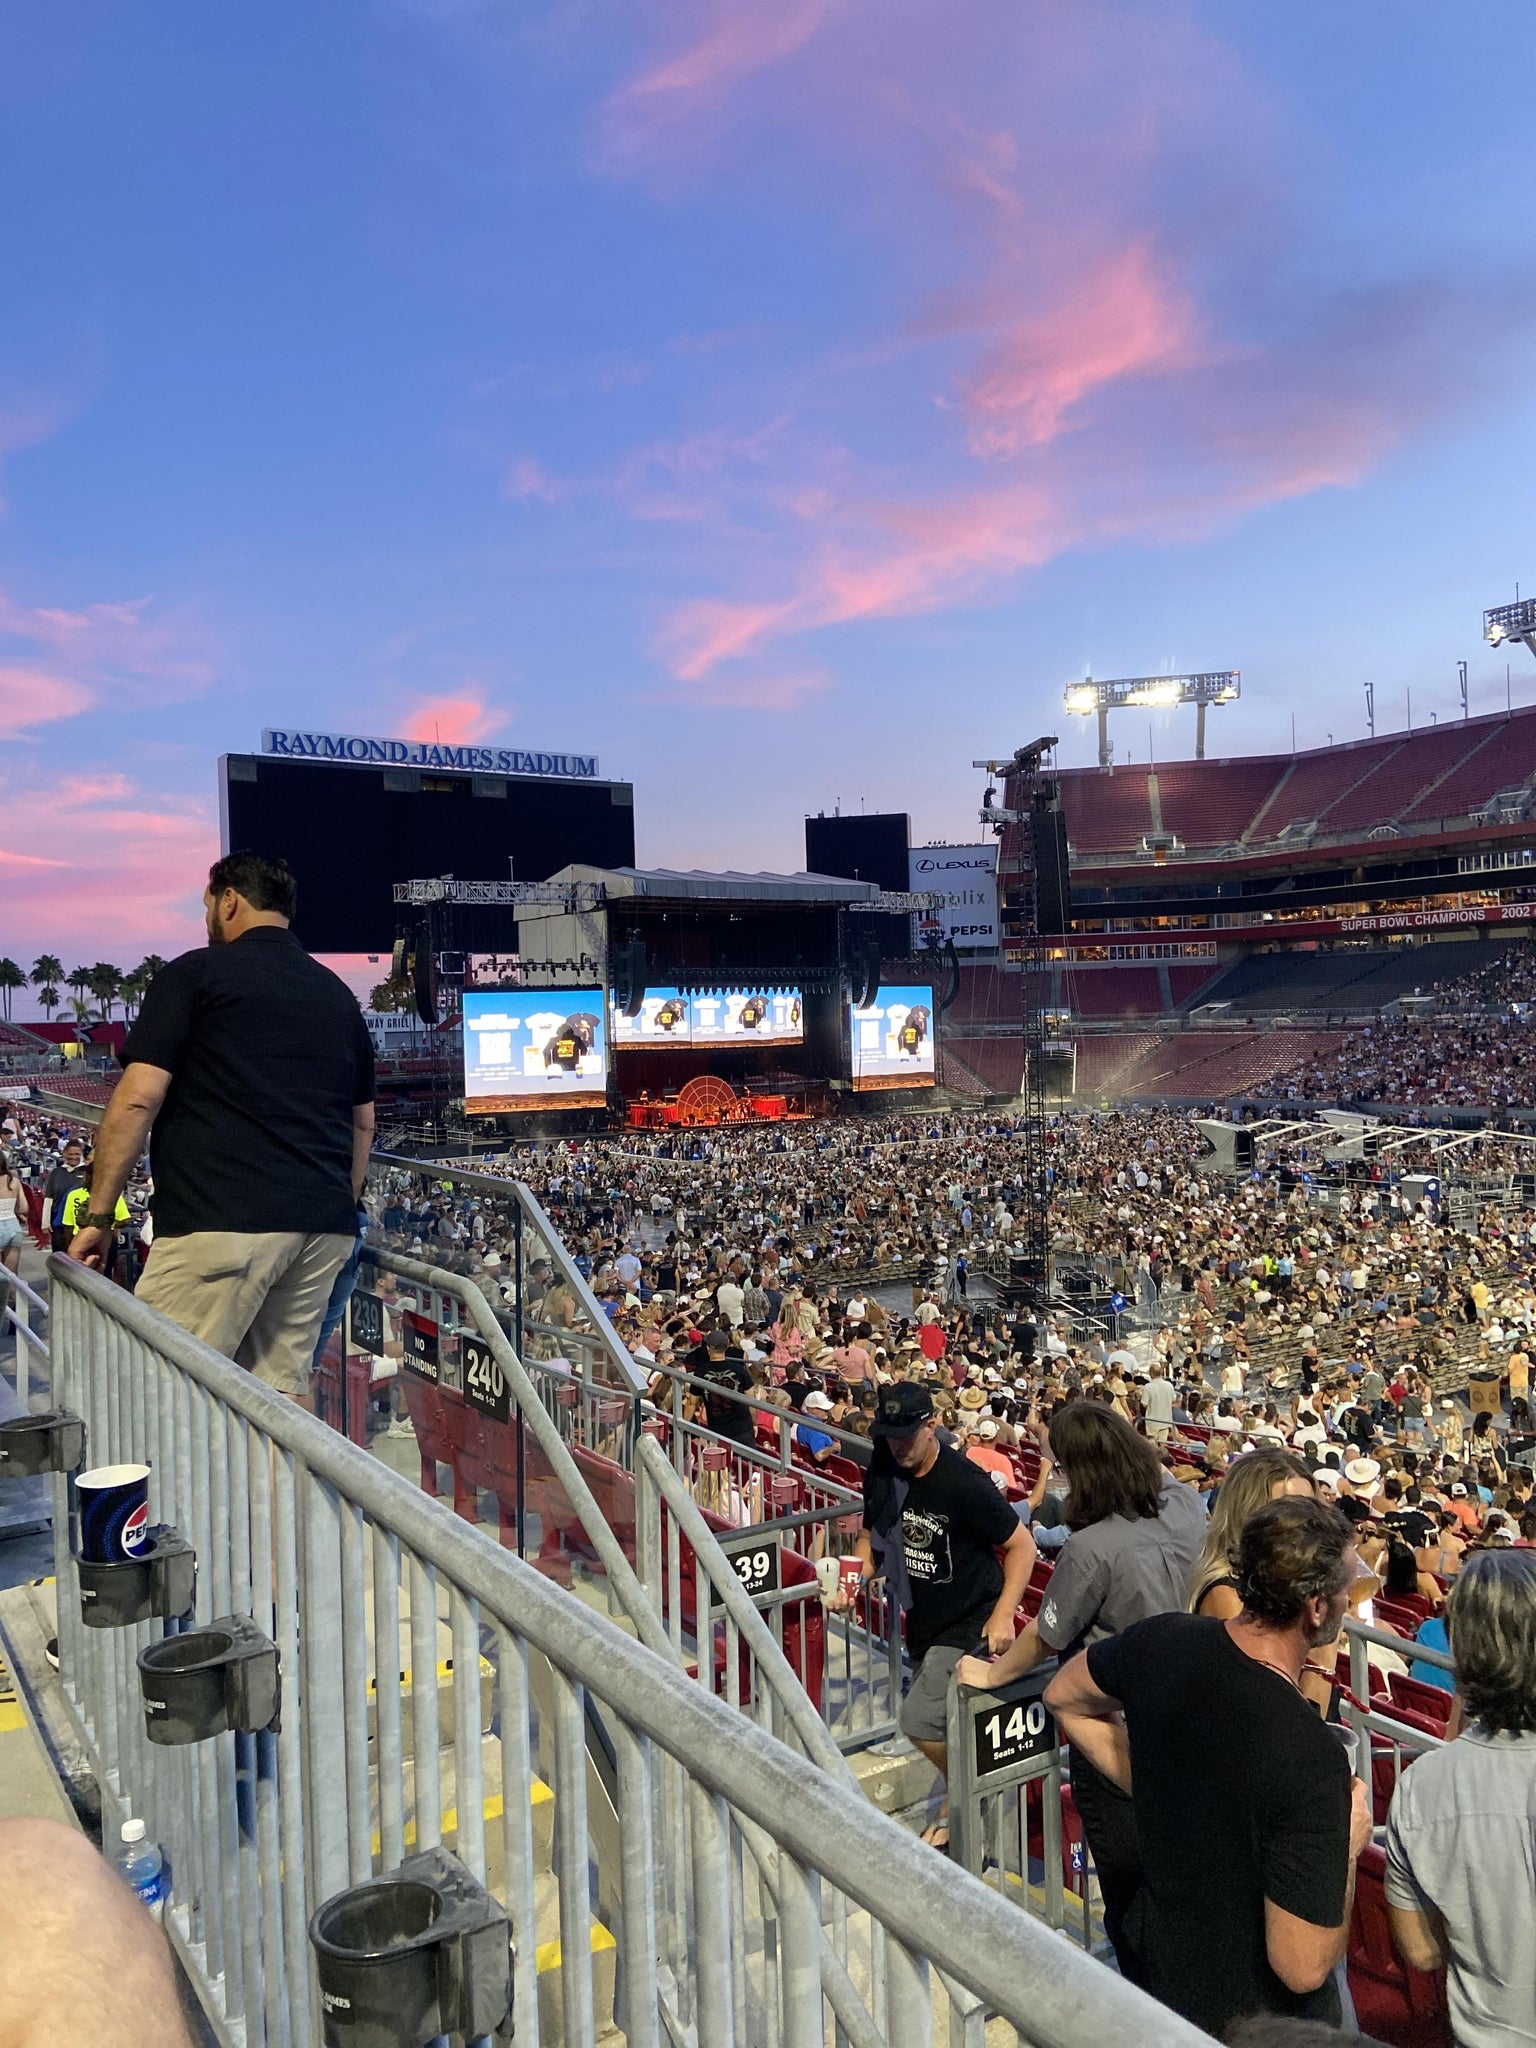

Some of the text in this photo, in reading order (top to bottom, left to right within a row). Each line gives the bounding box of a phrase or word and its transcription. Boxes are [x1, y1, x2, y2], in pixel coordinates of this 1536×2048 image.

[269, 731, 598, 778] RAYMOND JAMES STADIUM
[936, 859, 990, 870] LEXUS
[950, 924, 993, 936] PEPSI
[1341, 906, 1531, 931] SUPER BOWL CHAMPIONS 2002
[367, 1017, 410, 1029] WAY GRILL
[353, 1296, 379, 1333] 239
[414, 1336, 425, 1351] NO
[403, 1351, 438, 1378] STANDING
[467, 1348, 504, 1398] 240
[903, 1545, 935, 1562] nnessee
[735, 1551, 770, 1583] 39
[745, 1579, 763, 1590] 13-24
[985, 1701, 1046, 1750] 140
[993, 1739, 1034, 1760] Seats 1-12
